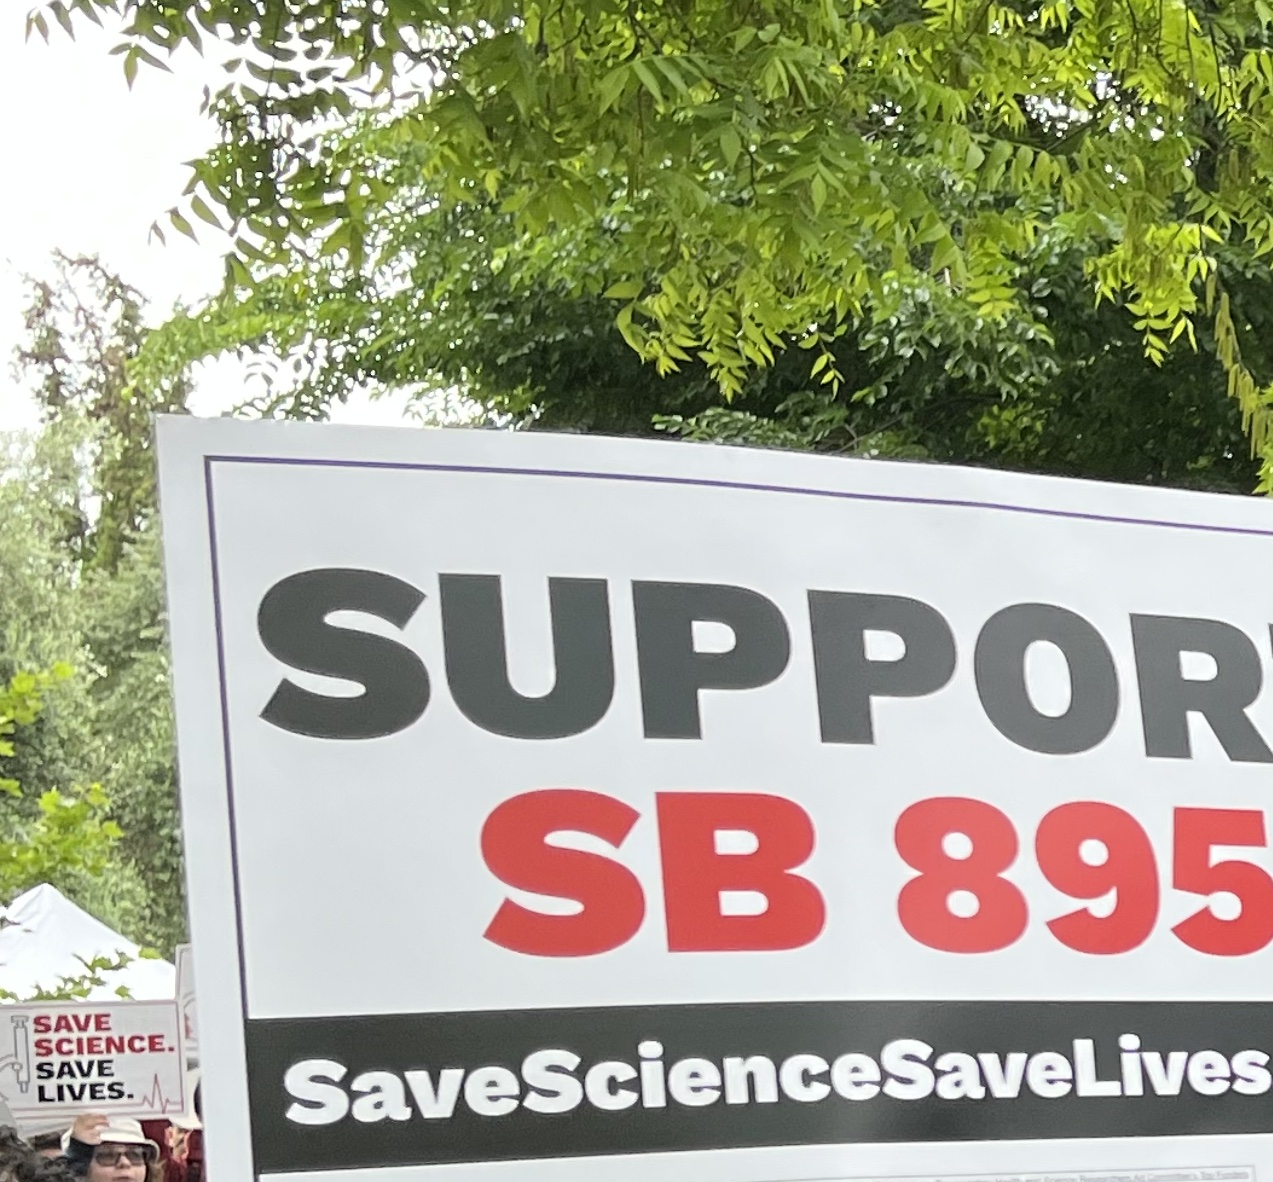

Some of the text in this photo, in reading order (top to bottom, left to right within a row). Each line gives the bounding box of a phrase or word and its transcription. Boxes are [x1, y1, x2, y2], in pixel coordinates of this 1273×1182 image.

[481, 789, 825, 957] SB
[33, 1013, 112, 1034] SAVE
[34, 1034, 175, 1057] SCIENCE.
[36, 1059, 114, 1080] SAVE
[37, 1081, 134, 1103] LIVES.
